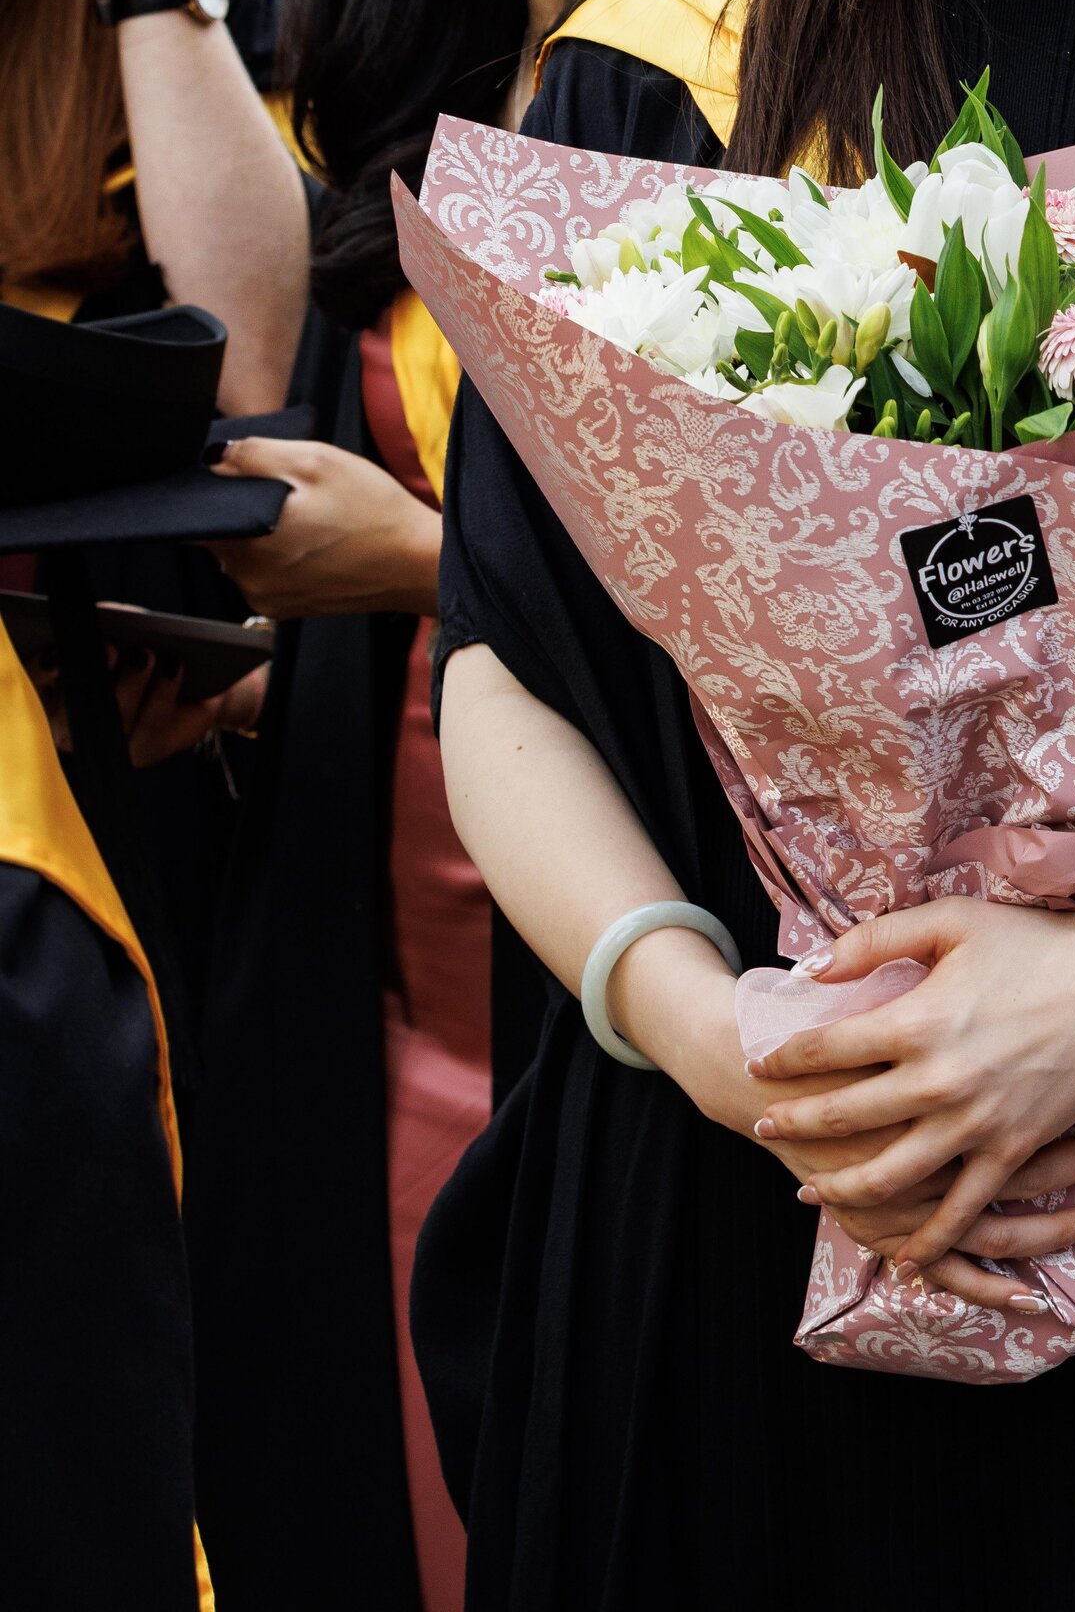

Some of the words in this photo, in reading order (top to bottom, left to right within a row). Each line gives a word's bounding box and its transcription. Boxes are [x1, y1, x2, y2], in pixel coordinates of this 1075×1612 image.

[918, 534, 1036, 593] Flowers
[947, 560, 1025, 604] @Halswell
[935, 614, 959, 628] FOR
[959, 617, 985, 628] ANY
[988, 576, 1039, 622] OCCASION
[961, 601, 971, 610] Ph
[976, 601, 988, 611] Ext
